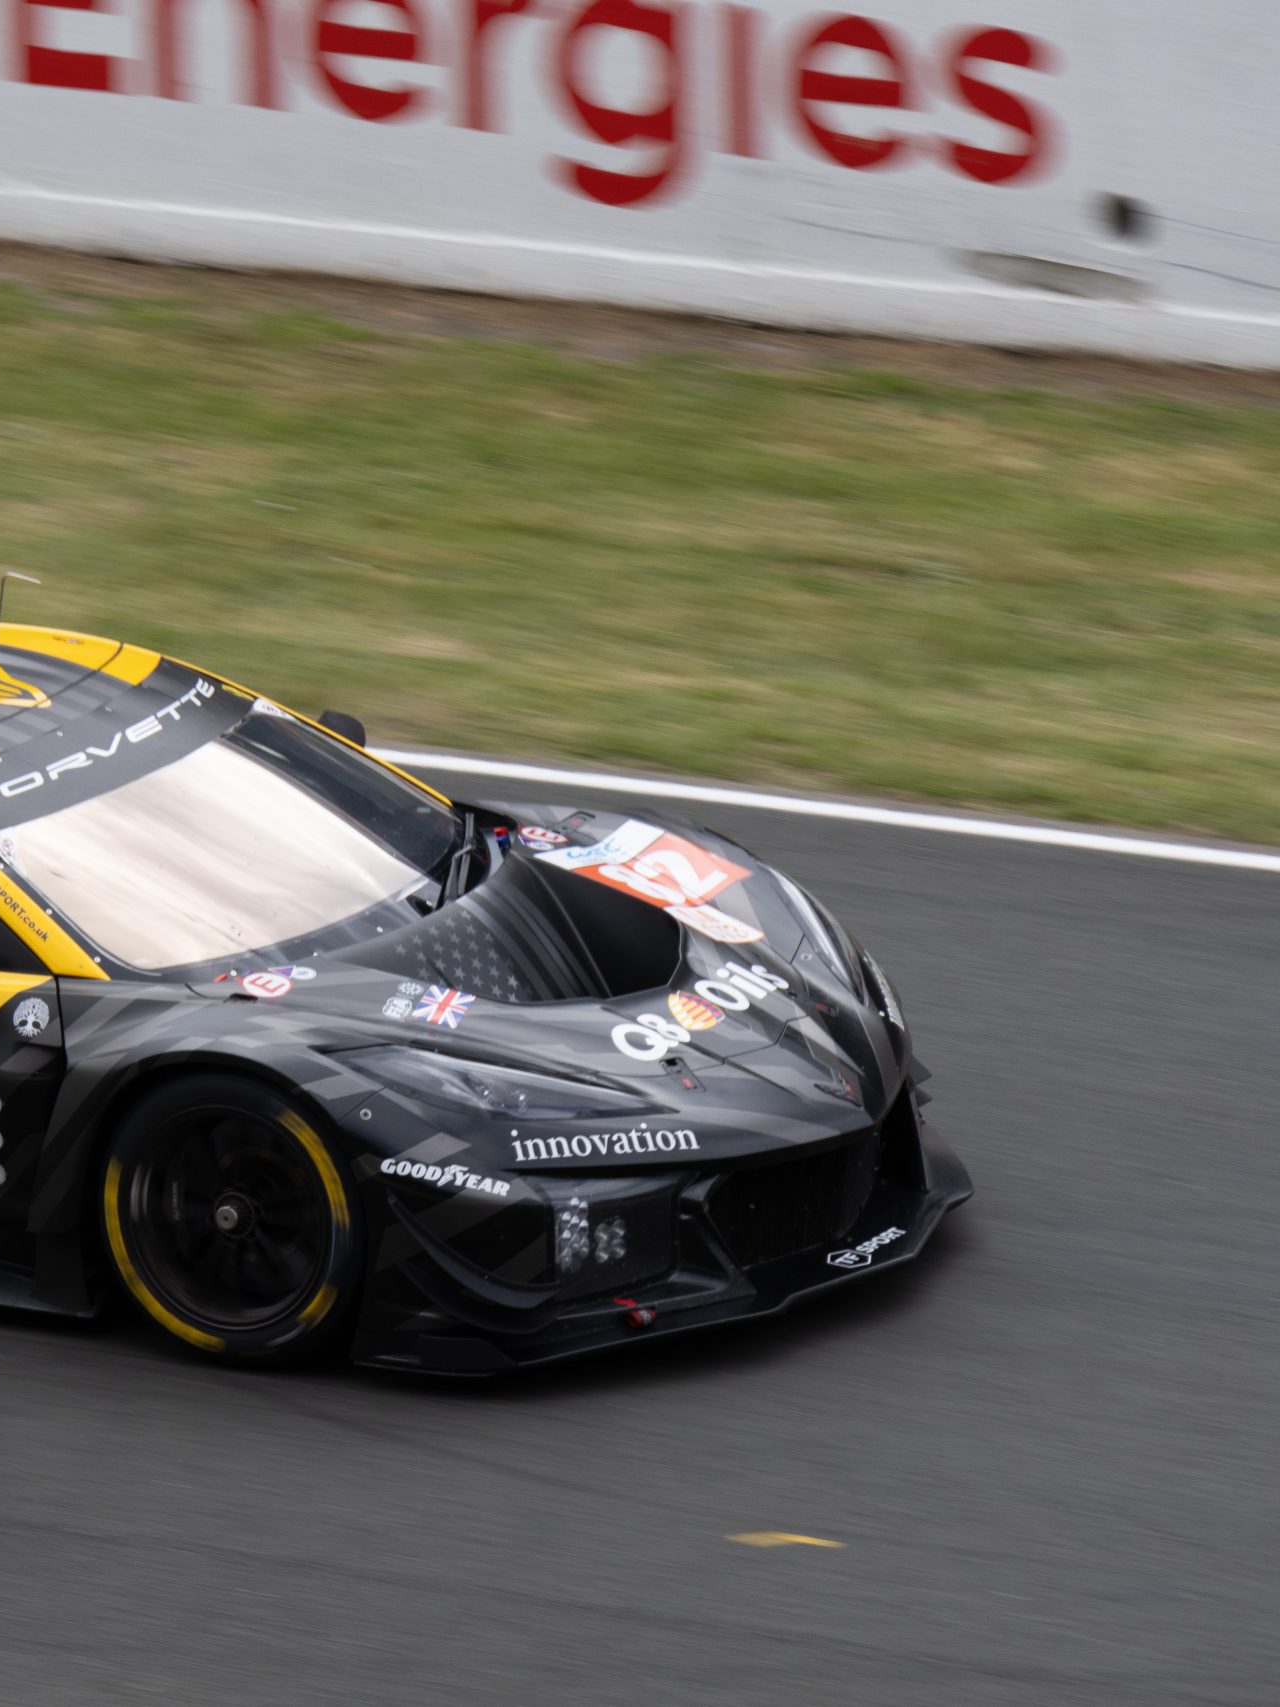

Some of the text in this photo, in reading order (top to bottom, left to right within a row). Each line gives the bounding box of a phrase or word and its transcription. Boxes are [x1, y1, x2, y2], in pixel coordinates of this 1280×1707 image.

[598, 850, 728, 903] 82
[611, 961, 790, 1061] Q8 Oils
[510, 1122, 701, 1162] innovation
[380, 1157, 511, 1197] GOODYEAR
[855, 1226, 907, 1253] SPORT
